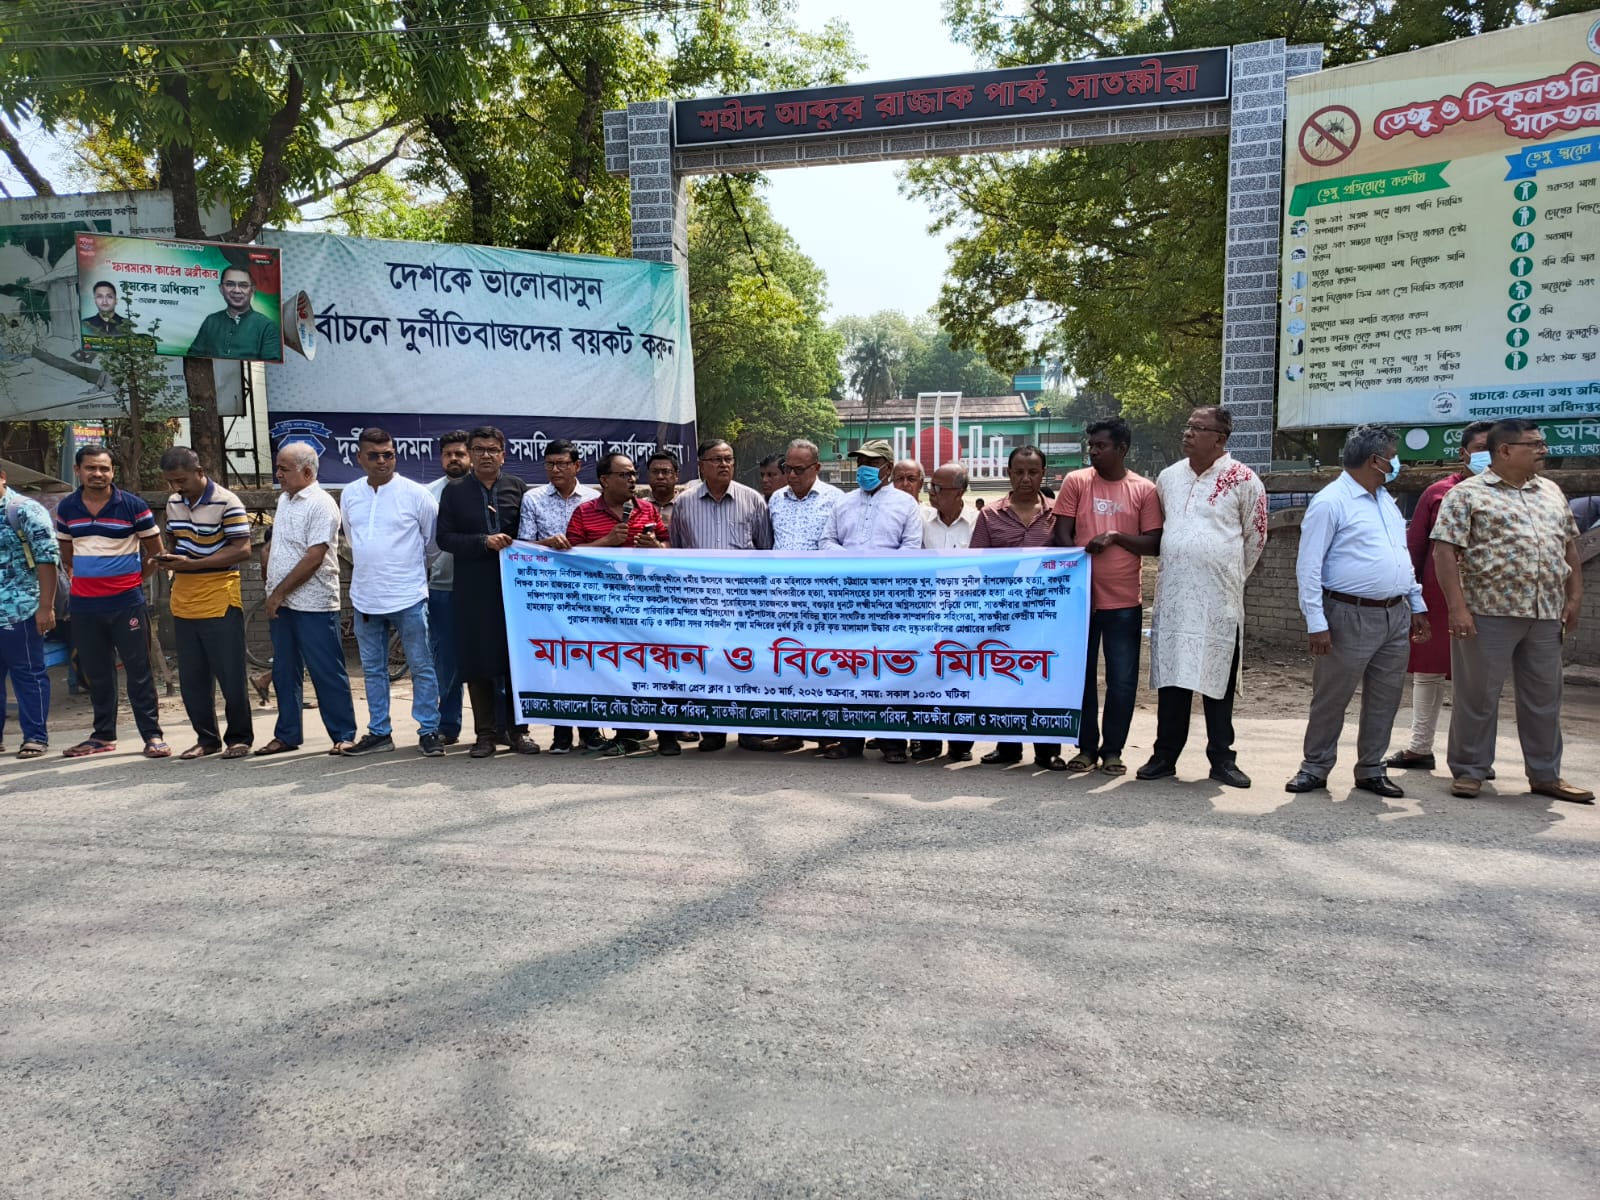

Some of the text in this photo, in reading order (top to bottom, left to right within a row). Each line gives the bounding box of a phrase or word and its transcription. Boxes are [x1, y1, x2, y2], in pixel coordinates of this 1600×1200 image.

[697, 58, 1198, 133] শহীদ আব্দুর রাজ্জাক পার্ক, সাতক্ষীরা
[1380, 68, 1600, 134] ডেঙ্গু ও চিকুনগুনি
[1510, 103, 1600, 134] সচেতন
[1526, 150, 1552, 168] ডেঙ্গু
[1318, 169, 1426, 202] ডেঙ্গু প্রতিরোধে করণীয়
[385, 262, 604, 310] দেশকে ভালোবাসুন
[1538, 302, 1553, 315] বমি
[314, 304, 390, 345] র্বাচনে
[397, 308, 562, 354] দুর্নীতিবাজদের
[568, 322, 634, 357] বয়কট
[639, 334, 676, 364] করুন
[1513, 388, 1544, 399] জেলা
[1548, 387, 1572, 396] তথ্য
[1576, 382, 1600, 396] অফি
[1553, 418, 1600, 440] অফি
[336, 427, 363, 468] দুর্নী
[394, 437, 434, 461] দমন
[508, 430, 554, 462] সমন্বি
[571, 438, 604, 462] জলা
[528, 636, 1056, 683] মানববন্ধন ও বিক্ষোভ মিছিল
[651, 679, 686, 692] সাতক্ষীরা
[688, 683, 706, 692] প্রেস
[707, 684, 724, 693] ক্লাব
[763, 686, 776, 695] ১৩
[777, 684, 795, 697] মার্চ,
[797, 687, 823, 696] ২০২৬
[825, 688, 858, 698] শুক্রবার,
[885, 689, 910, 698] সকাল
[944, 687, 970, 698] ঘটিকা
[552, 699, 589, 713] বাংলাদেশ
[590, 697, 608, 716] হিন্দু
[609, 697, 629, 714] বৌদ্ধ
[659, 700, 678, 716] ঐক্য
[680, 700, 711, 720] পরিষদ,
[711, 702, 747, 719] সাতক্ষীরা
[749, 707, 770, 720] জেলা
[780, 708, 819, 722] বাংলাদেশ
[821, 709, 840, 725] পূজা
[879, 707, 911, 727] পরিষদ,
[912, 708, 951, 725] সাতক্ষীরা
[953, 713, 976, 726] জেলা
[978, 713, 986, 726] ও
[988, 714, 1027, 729] সংখ্যালঘু
